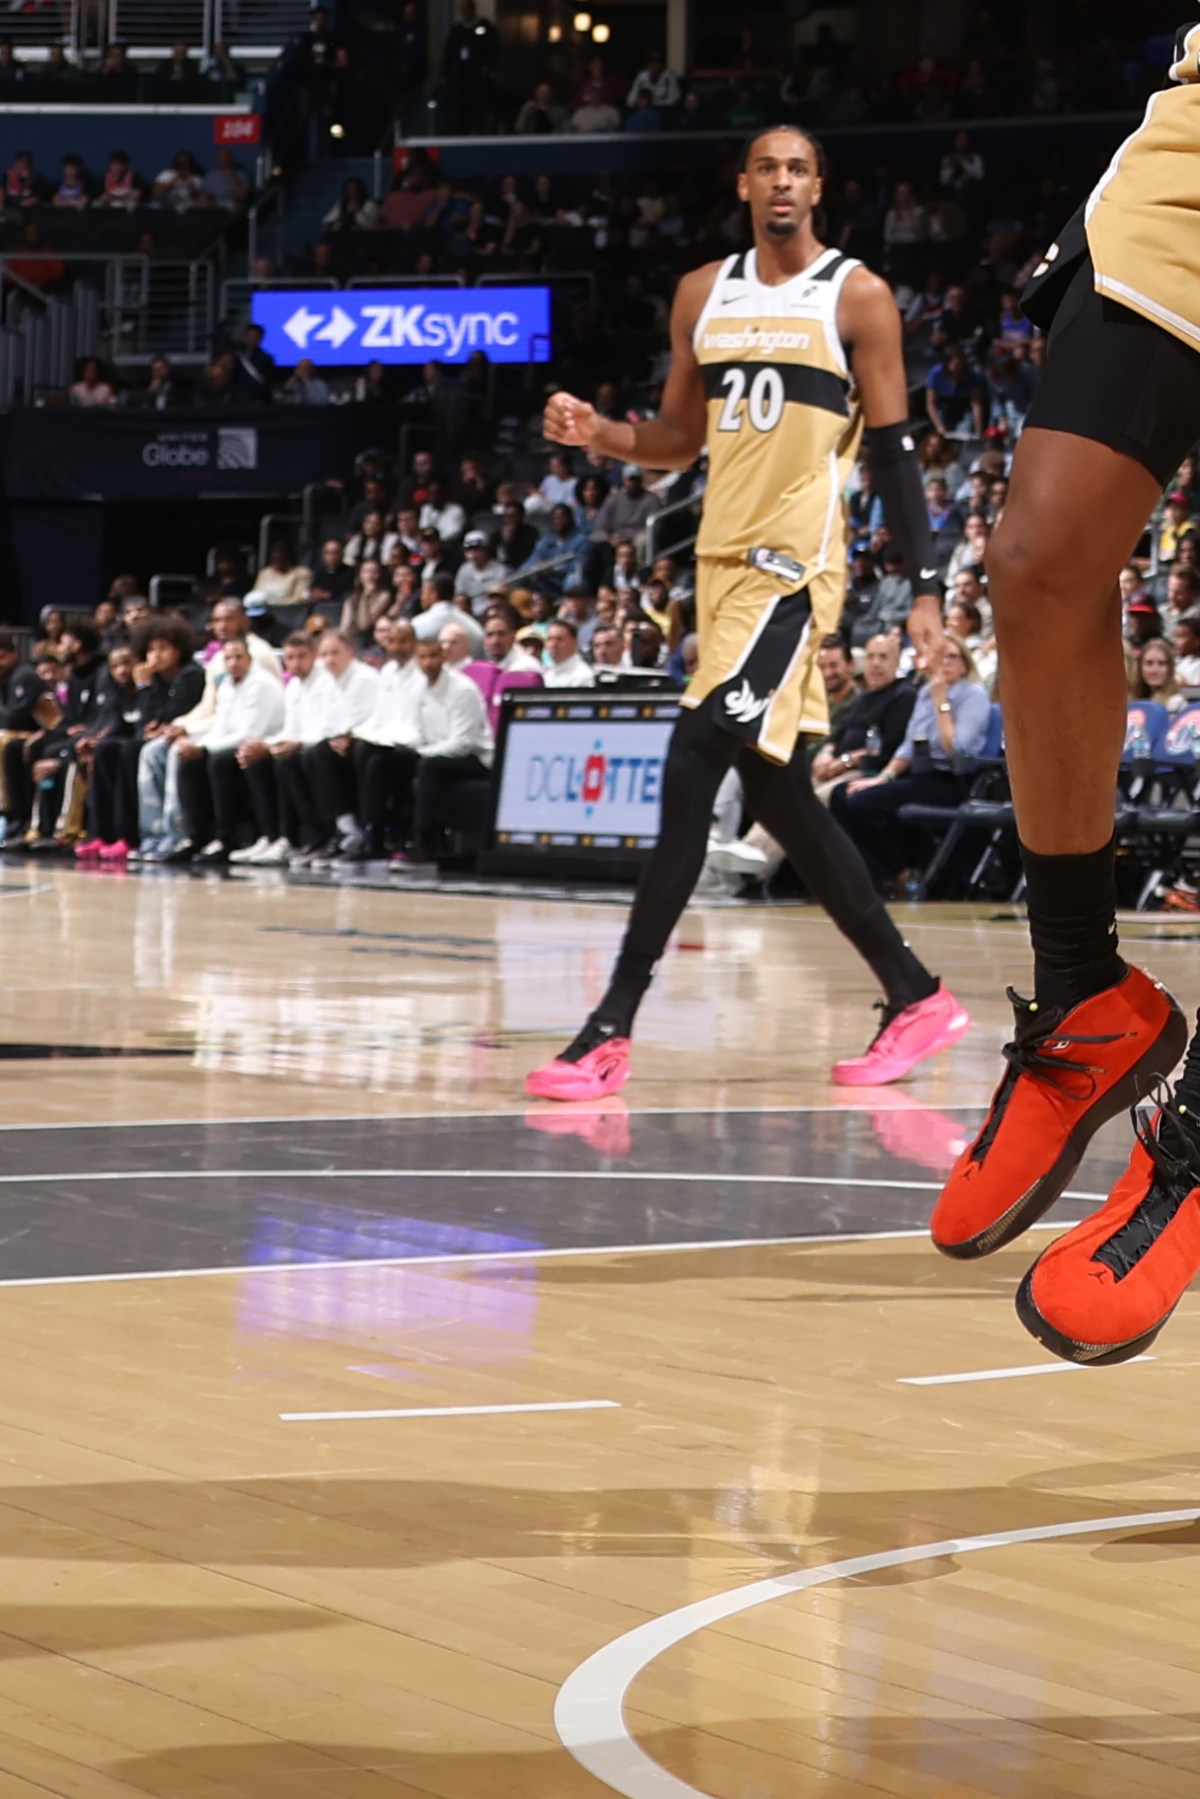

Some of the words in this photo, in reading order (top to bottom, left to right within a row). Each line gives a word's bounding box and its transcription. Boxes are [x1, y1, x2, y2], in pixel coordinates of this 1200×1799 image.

[360, 304, 519, 357] ZKsync
[703, 325, 811, 355] washington
[717, 367, 785, 433] 20
[142, 441, 211, 468] Globe
